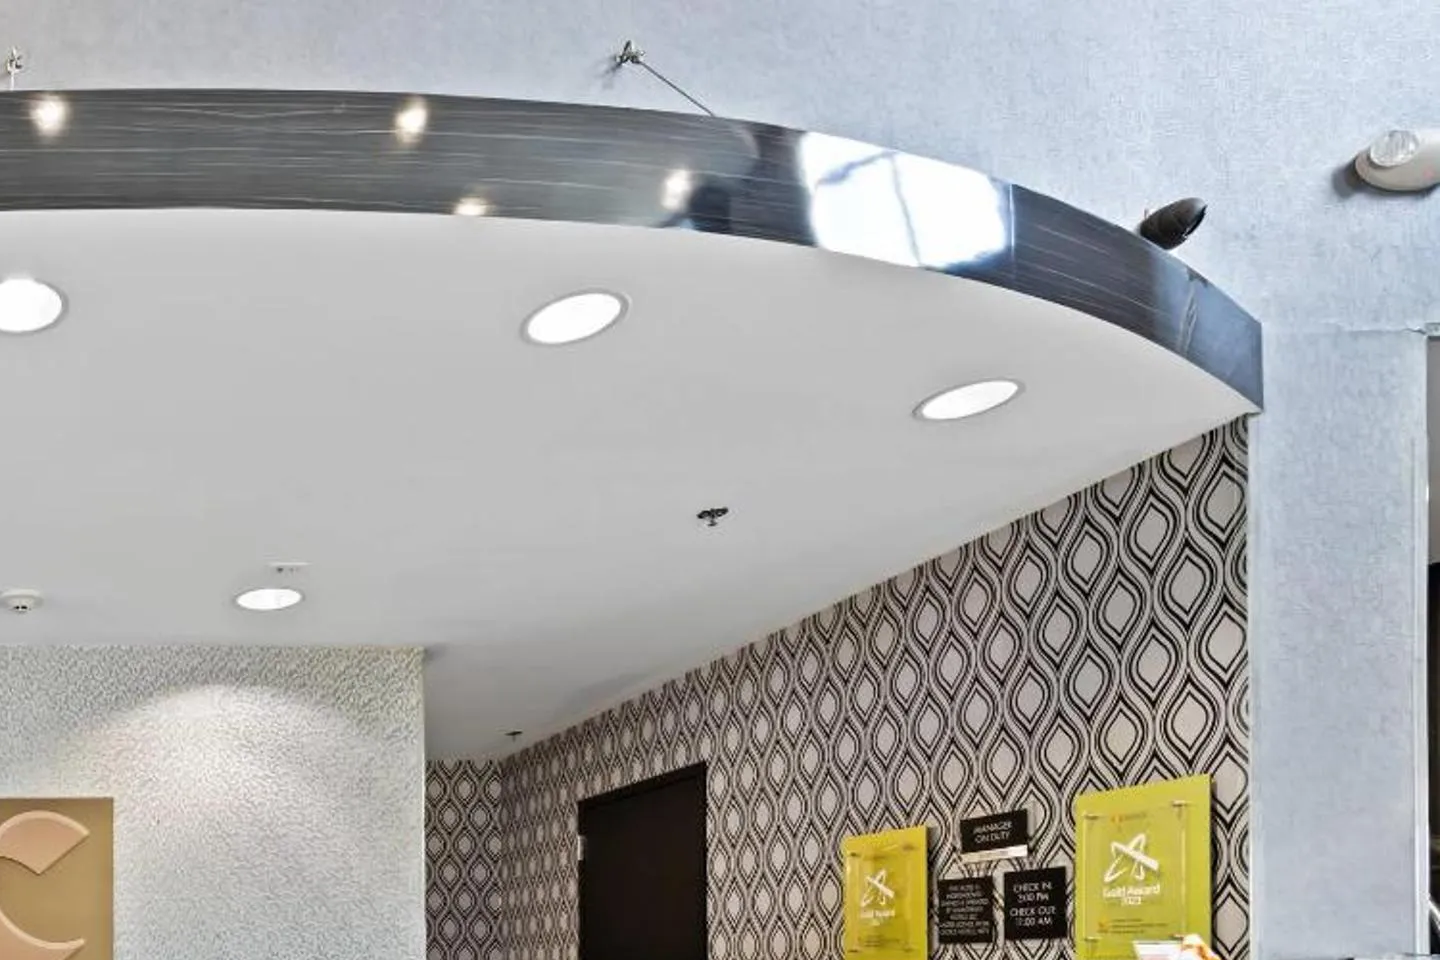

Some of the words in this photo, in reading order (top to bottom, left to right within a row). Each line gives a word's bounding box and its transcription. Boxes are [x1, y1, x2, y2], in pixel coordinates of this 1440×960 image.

[972, 821, 1013, 835] MANAGER
[974, 834, 989, 844] ON
[990, 831, 1011, 842] DUTY
[1013, 882, 1039, 893] CHECK
[1009, 907, 1036, 917] CHECK
